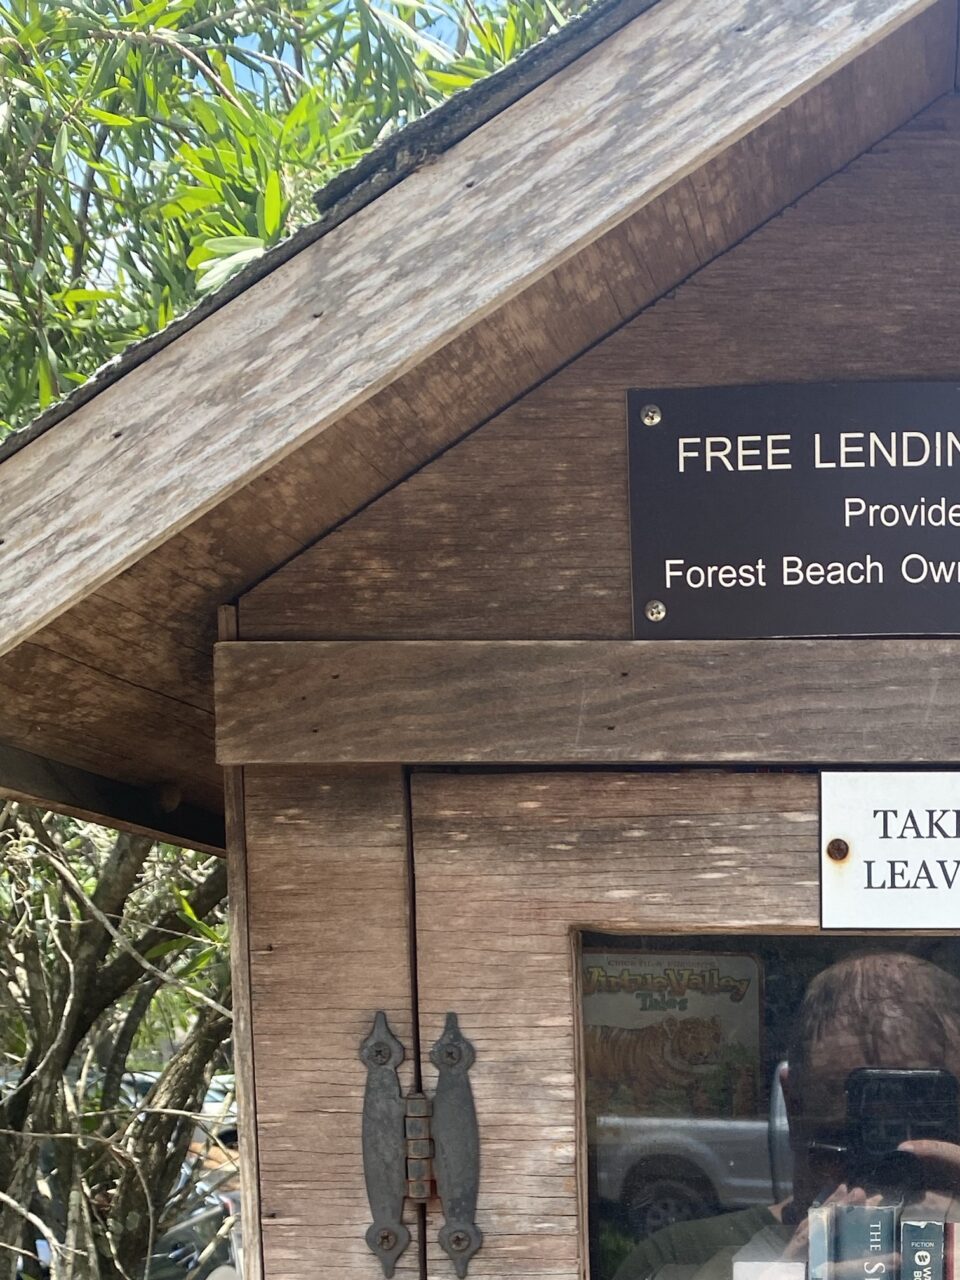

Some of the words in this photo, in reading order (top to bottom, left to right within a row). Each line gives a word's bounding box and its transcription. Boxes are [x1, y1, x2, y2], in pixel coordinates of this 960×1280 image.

[677, 434, 792, 472] FREE
[665, 558, 766, 588] Forest
[782, 555, 884, 585] Beach
[869, 1221, 881, 1252] THE
